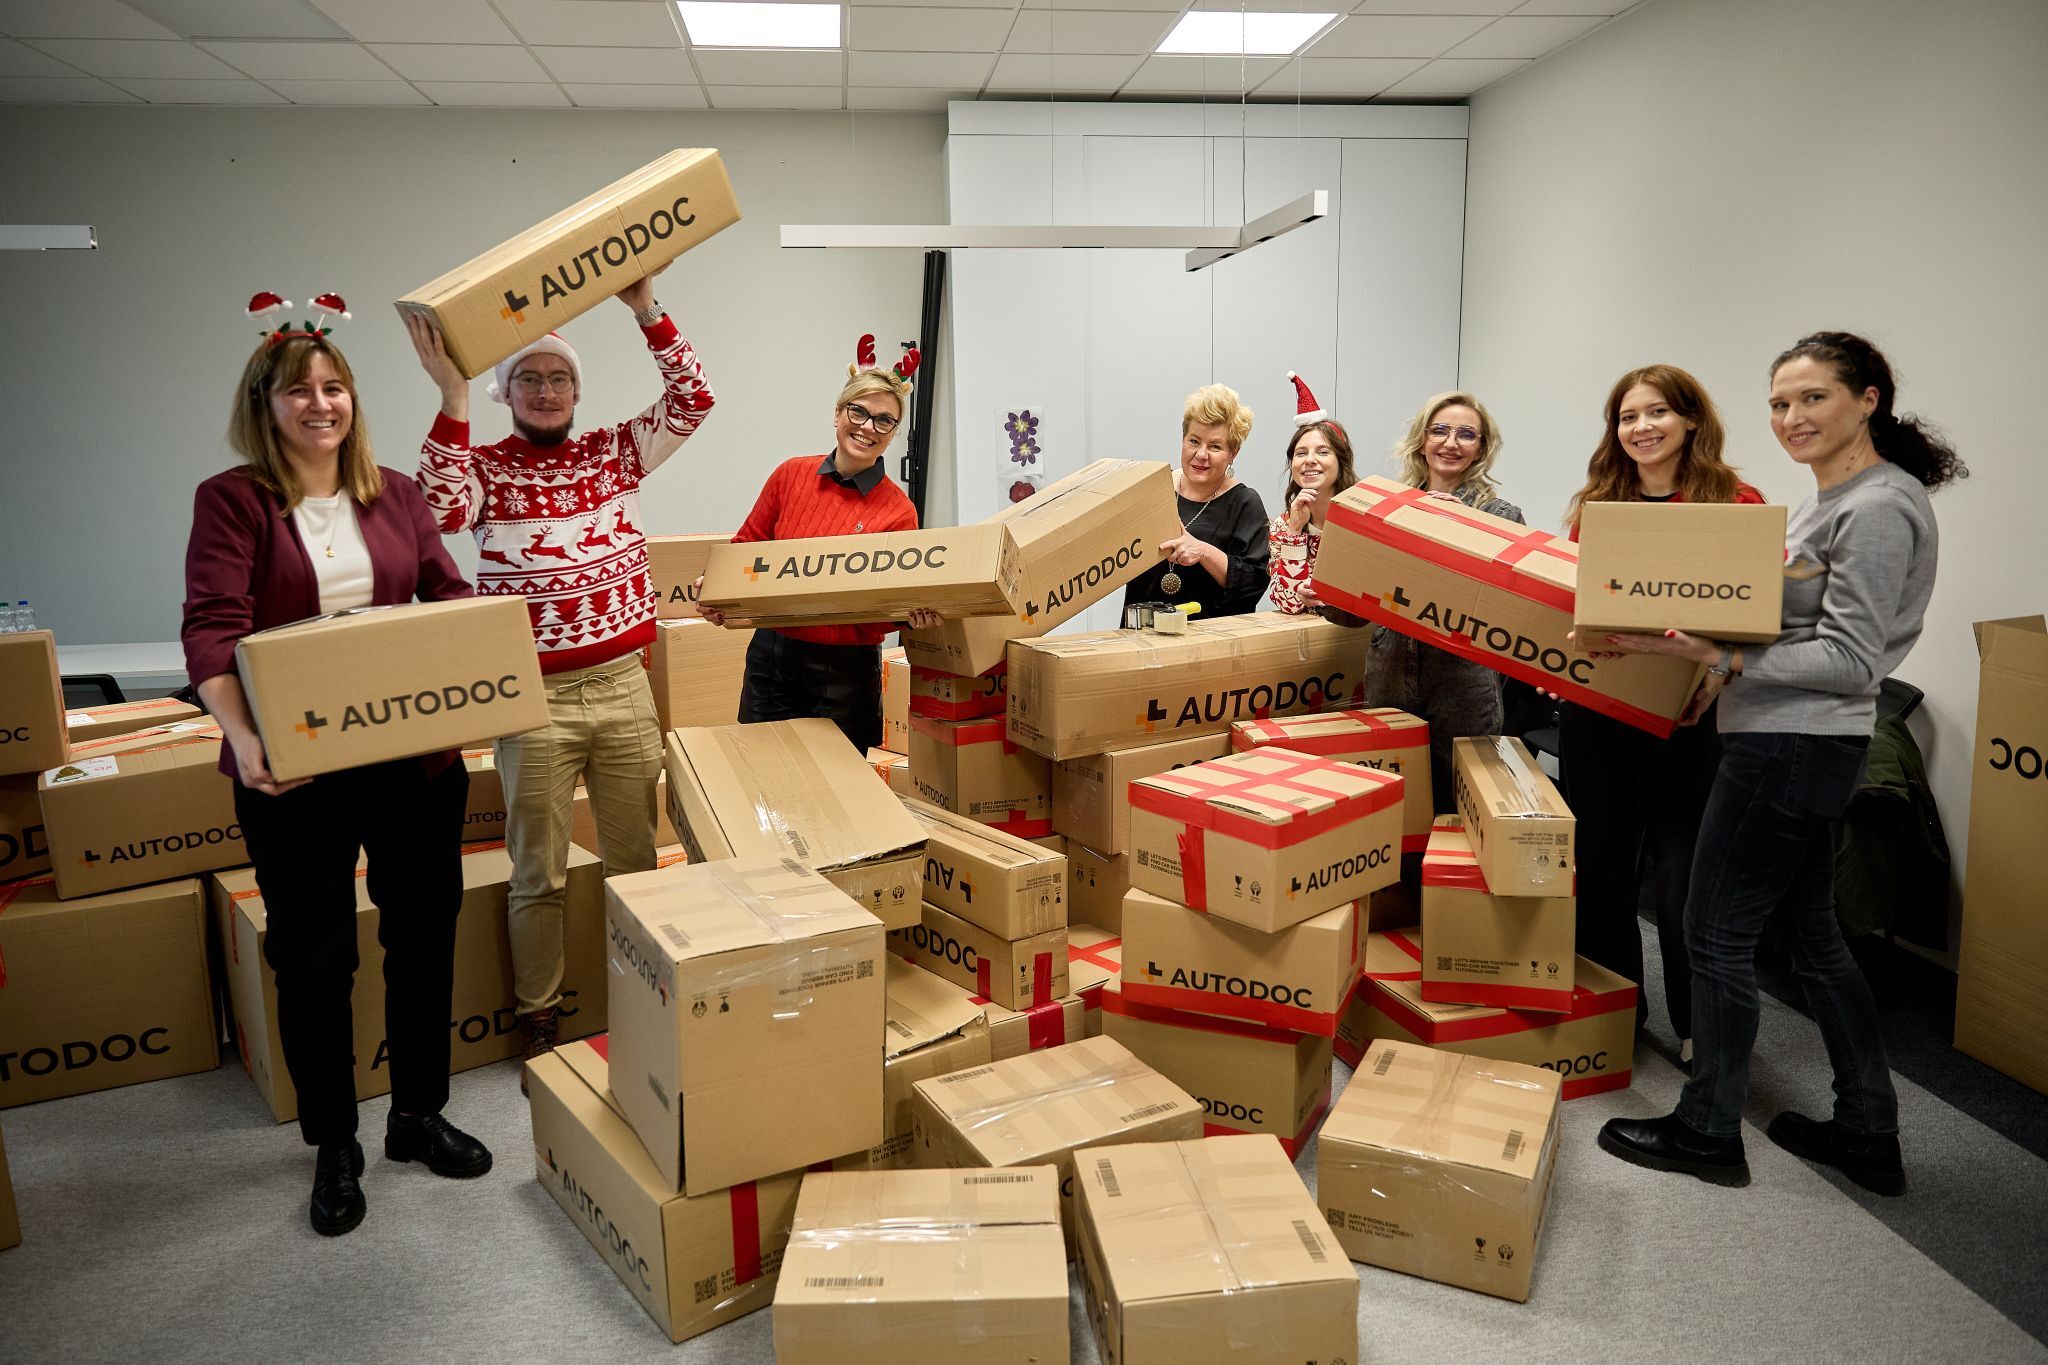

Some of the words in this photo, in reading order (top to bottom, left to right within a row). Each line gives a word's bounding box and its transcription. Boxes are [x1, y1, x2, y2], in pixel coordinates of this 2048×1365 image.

[541, 197, 696, 308] AUTODOC
[776, 545, 948, 580] AUTODOC
[1045, 538, 1143, 615] AUTODOC
[1629, 581, 1751, 602] AUTODOC
[1416, 600, 1595, 686] AUTODOC
[341, 674, 521, 731] AUTODOC
[1175, 672, 1345, 728] AUTODOC
[1988, 737, 2048, 781] OC
[919, 781, 950, 810] AUTODOC
[109, 822, 244, 865] AUTODOC
[1150, 853, 1161, 861] LET'S
[923, 858, 955, 892] AU
[1305, 843, 1392, 894] AUTODOC
[609, 918, 657, 992] AUTODOC
[1169, 968, 1313, 1009] AUTODOC
[1191, 1096, 1264, 1124] ODOC
[562, 1168, 652, 1292] AUTODOC
[1348, 1219, 1366, 1227] WITH
[1348, 1224, 1363, 1233] TELL
[1363, 1216, 1399, 1229] PROBLEMS
